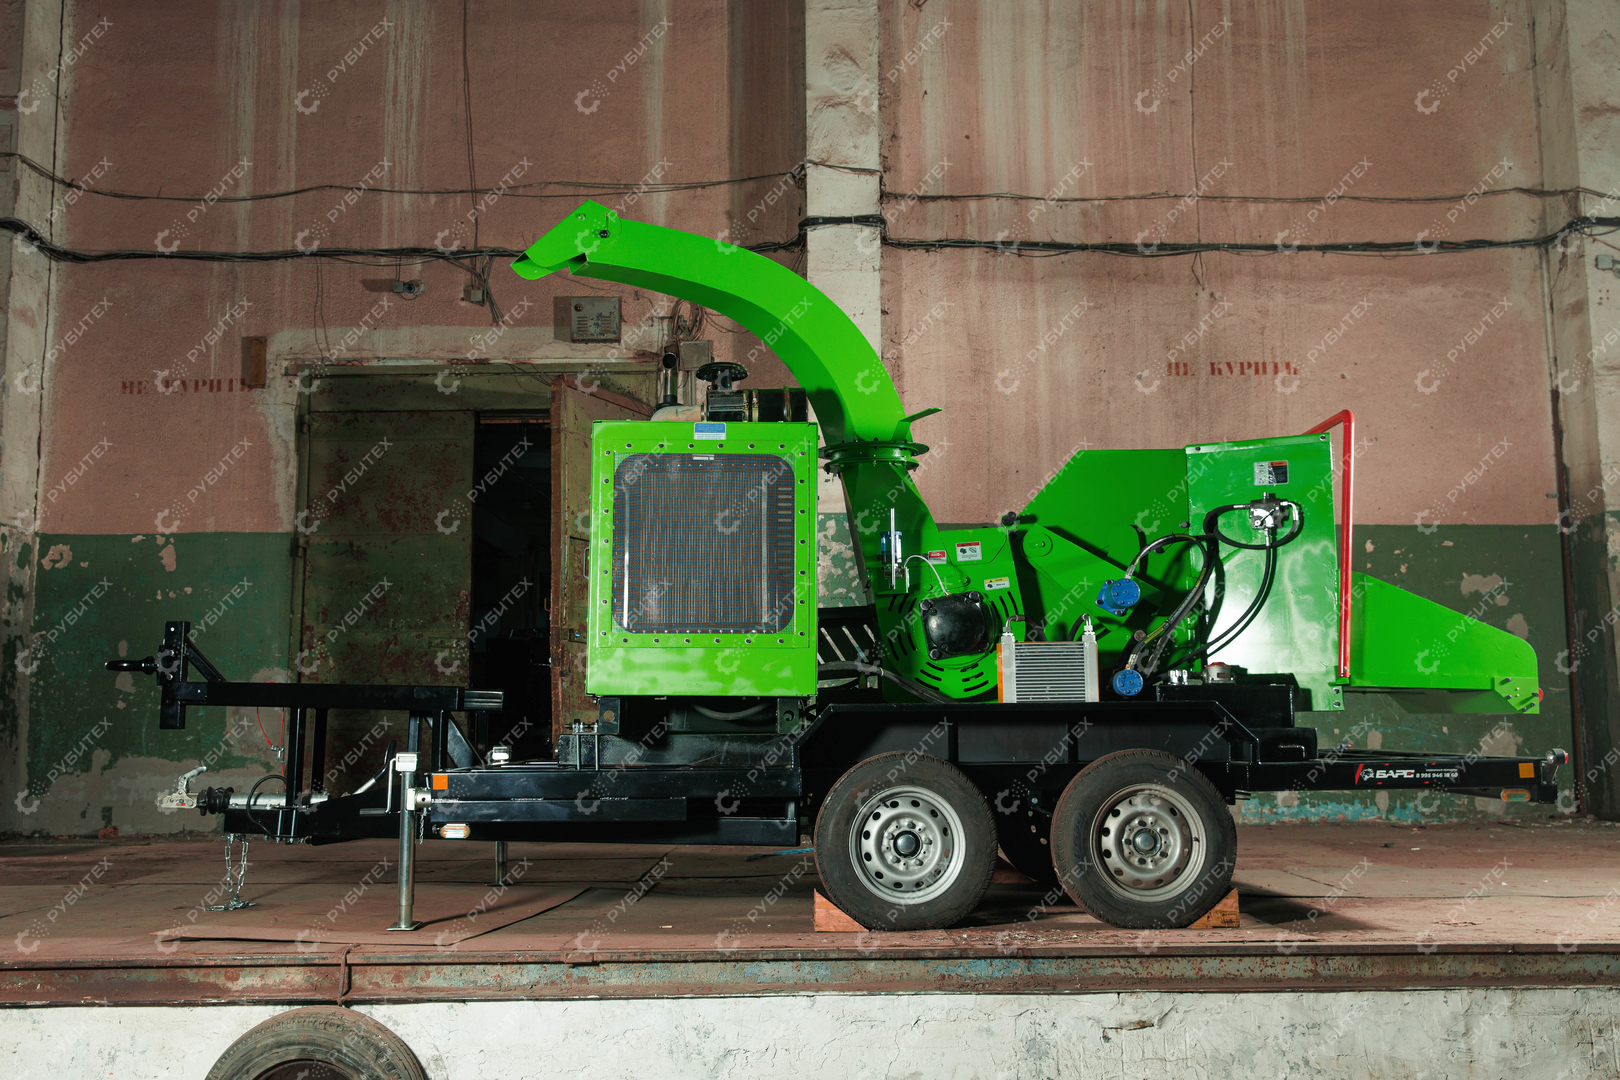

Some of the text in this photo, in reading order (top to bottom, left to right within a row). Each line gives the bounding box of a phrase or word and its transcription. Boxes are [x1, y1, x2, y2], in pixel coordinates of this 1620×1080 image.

[1167, 361, 1299, 377] НЕ КУРИТЬ
[1375, 769, 1415, 778] БАРС
